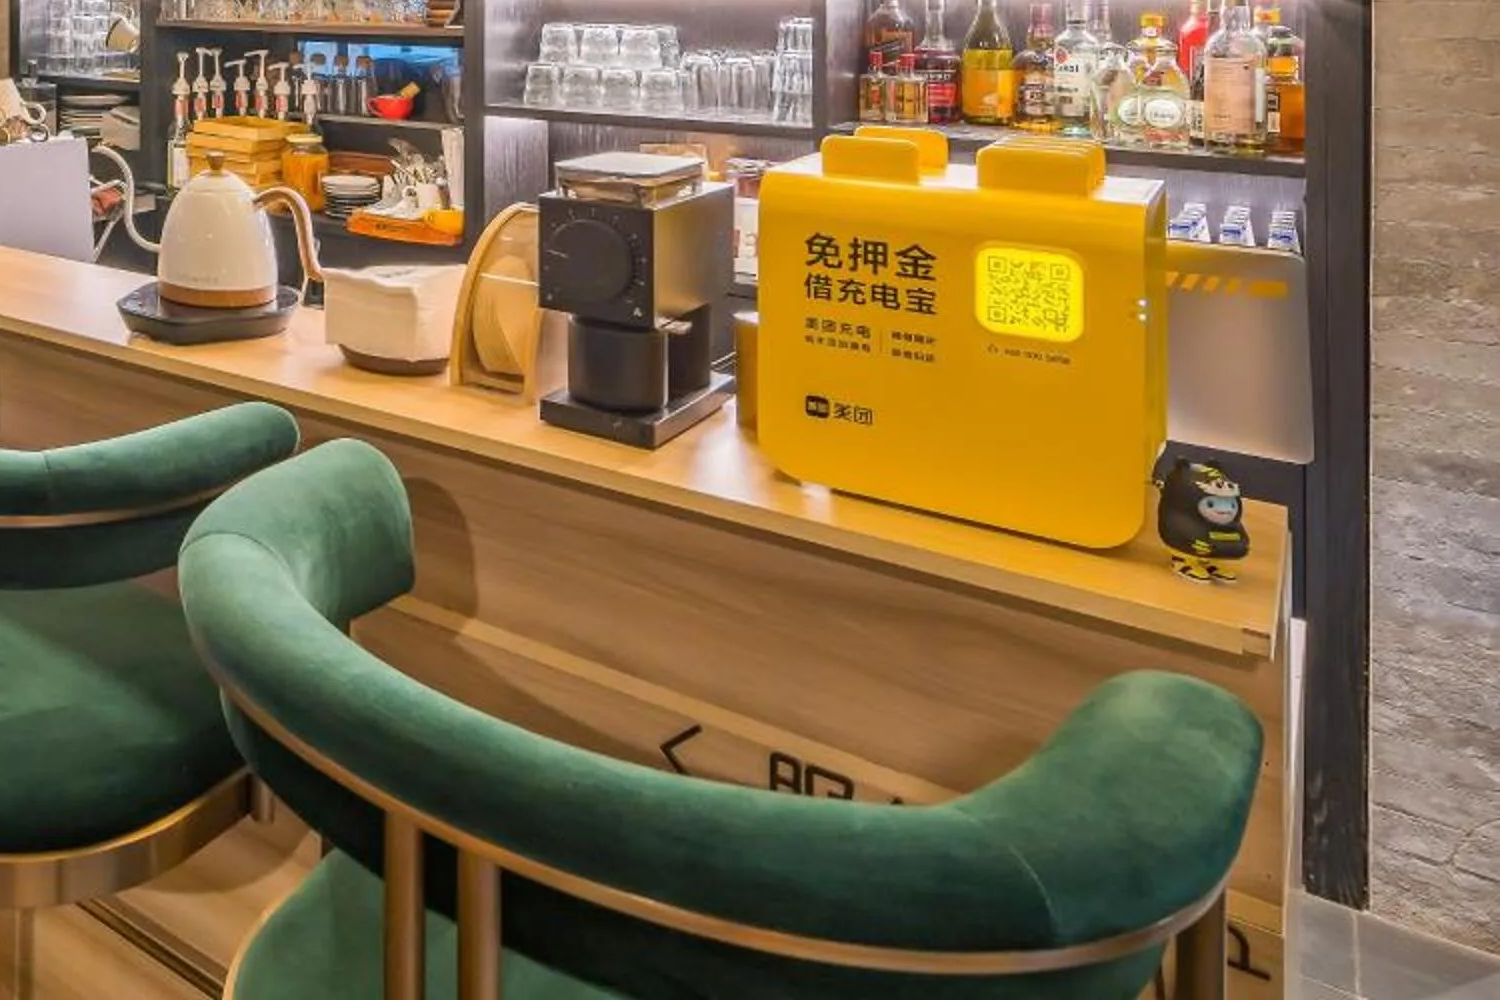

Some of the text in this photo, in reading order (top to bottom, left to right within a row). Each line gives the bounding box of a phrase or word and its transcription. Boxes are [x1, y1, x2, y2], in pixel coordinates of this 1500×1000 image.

[804, 232, 937, 281] 免押金
[804, 272, 937, 315] 借充电宝
